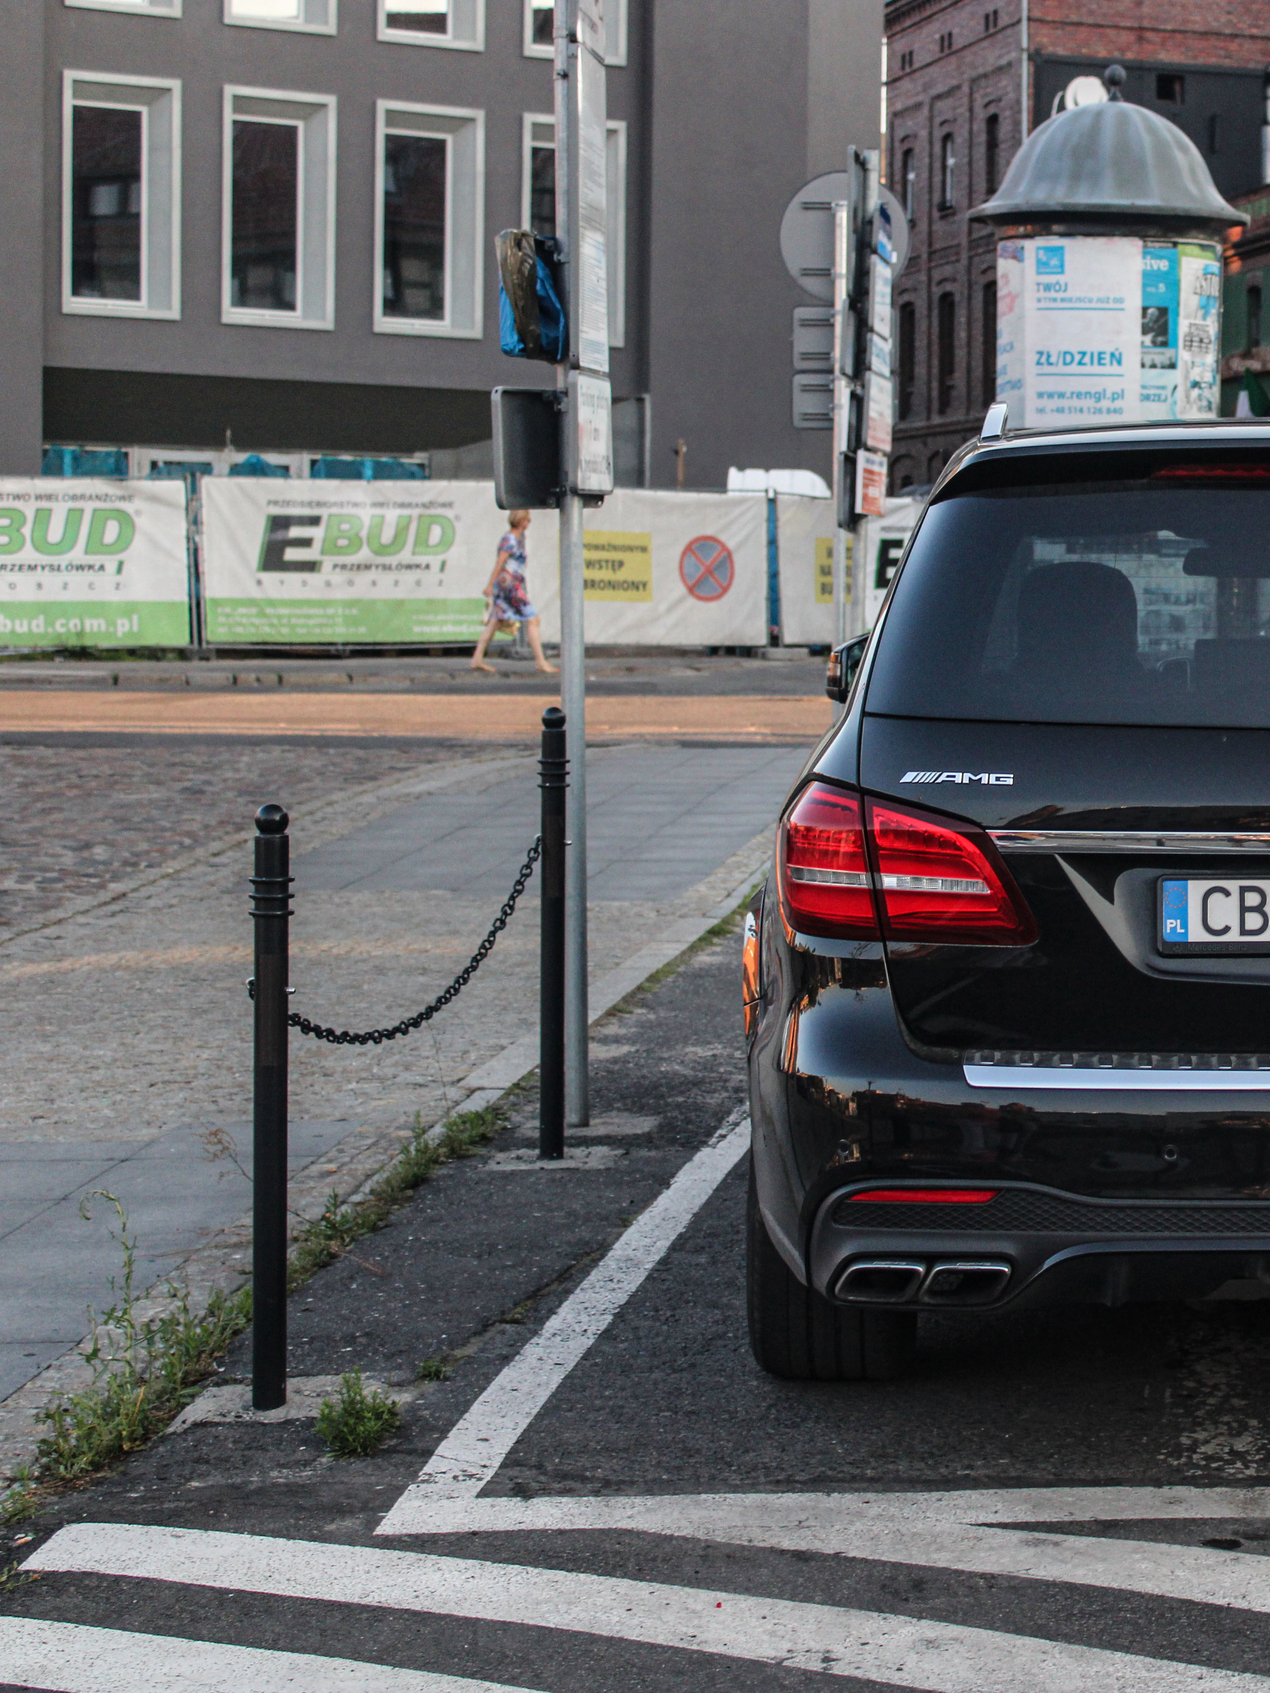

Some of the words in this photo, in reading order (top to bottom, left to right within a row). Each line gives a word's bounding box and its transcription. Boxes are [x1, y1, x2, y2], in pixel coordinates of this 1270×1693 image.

[1036, 280, 1068, 292] TWÓJ
[1035, 347, 1123, 367] ZŁ/DZIEŃ
[1036, 388, 1125, 403] www.rengl.pl
[0, 507, 136, 556] BUD
[256, 513, 456, 573] EBUD
[584, 559, 625, 574] WSTĘP
[934, 771, 1014, 786] AMG
[1201, 885, 1269, 936] CB
[1166, 919, 1185, 933] PL
